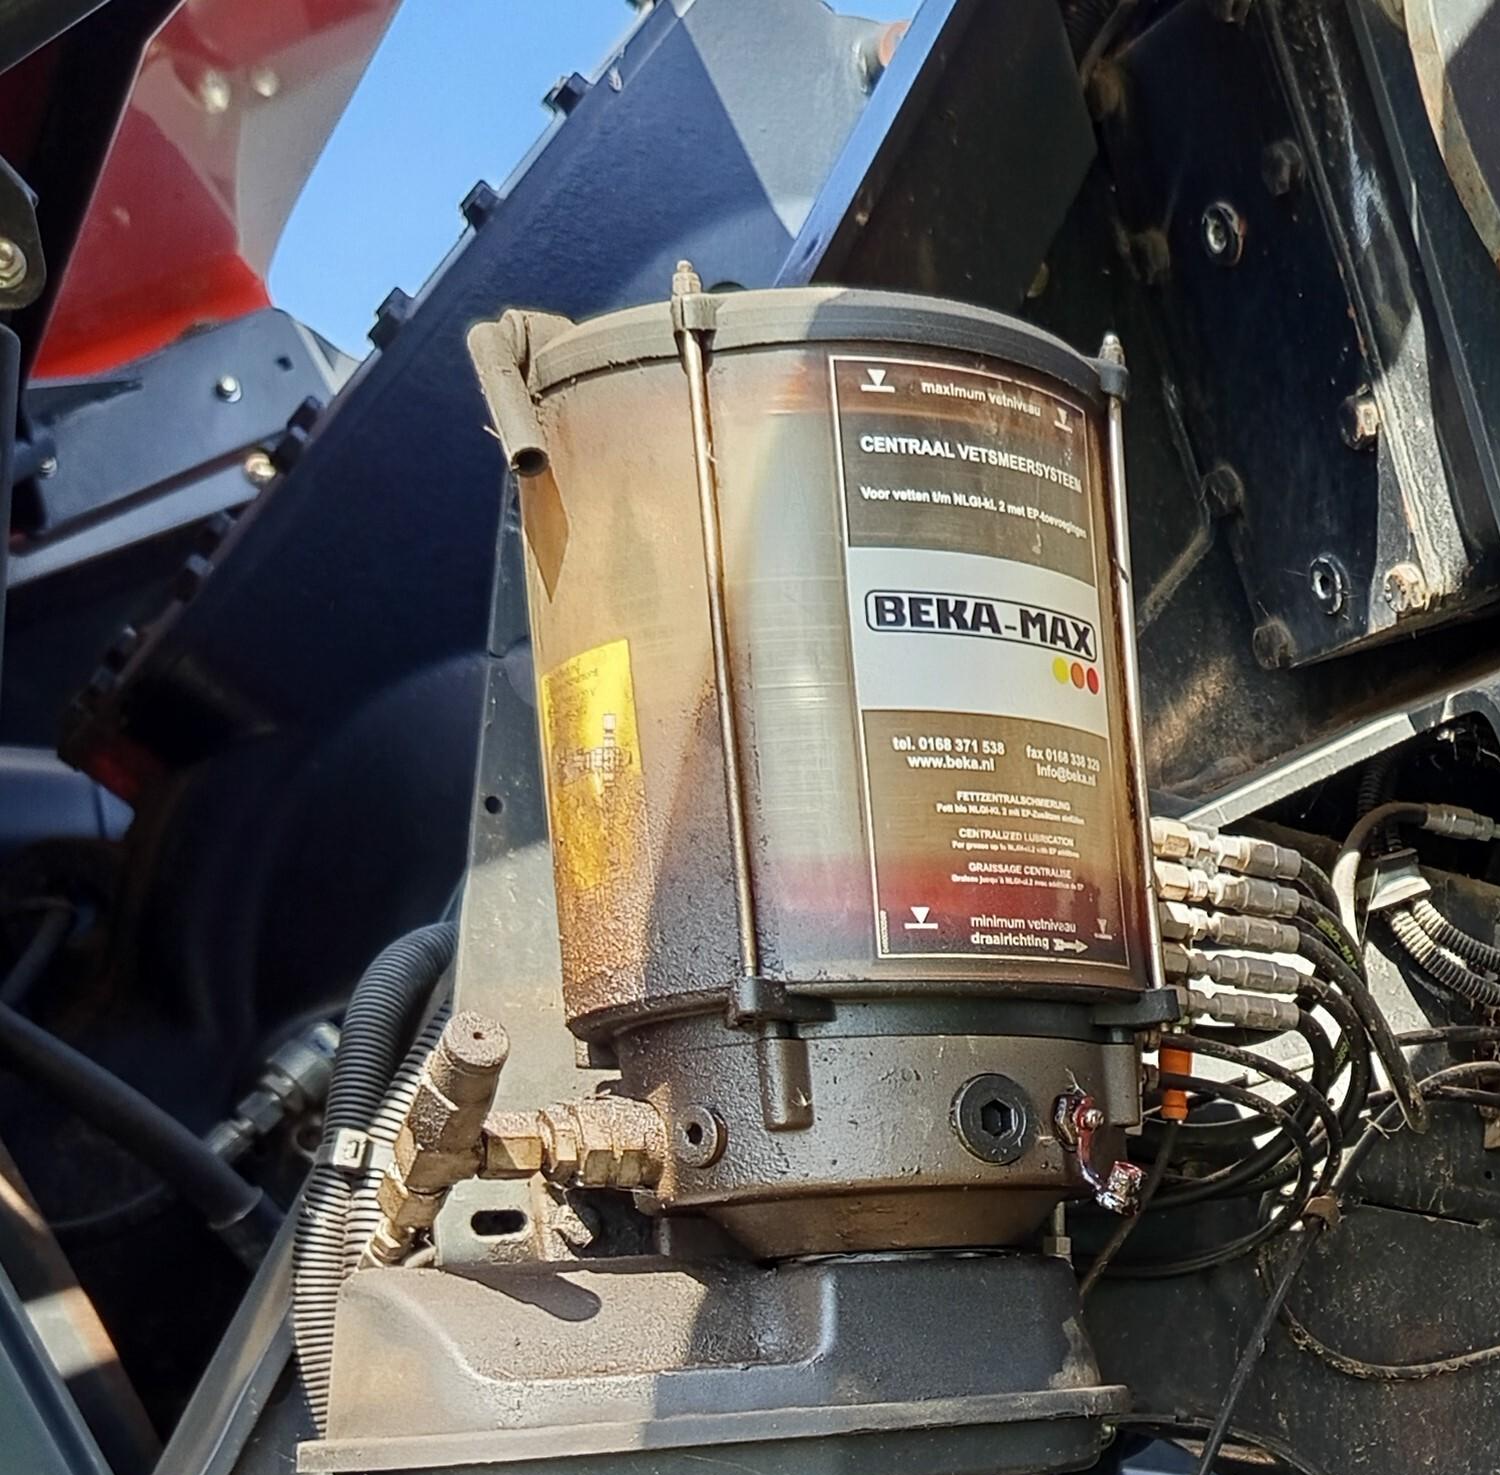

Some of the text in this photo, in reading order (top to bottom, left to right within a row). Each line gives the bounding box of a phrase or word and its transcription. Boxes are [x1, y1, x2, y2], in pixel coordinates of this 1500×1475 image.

[921, 381, 986, 402] maximum
[860, 435, 955, 459] CENTRAAL
[860, 486, 890, 501] Voor
[892, 488, 930, 503] vetten
[999, 501, 1006, 513] 2
[874, 595, 1093, 656] BEKA-MAX
[892, 736, 1005, 755] tel. 0168 371 538
[1025, 744, 1044, 760] fax
[1045, 748, 1069, 764] 0168
[907, 755, 995, 771] www.beka.nl
[968, 862, 1022, 874] GRAISSAGE
[970, 914, 1077, 932] minimum vetniveau
[970, 932, 1049, 950] draairichting
